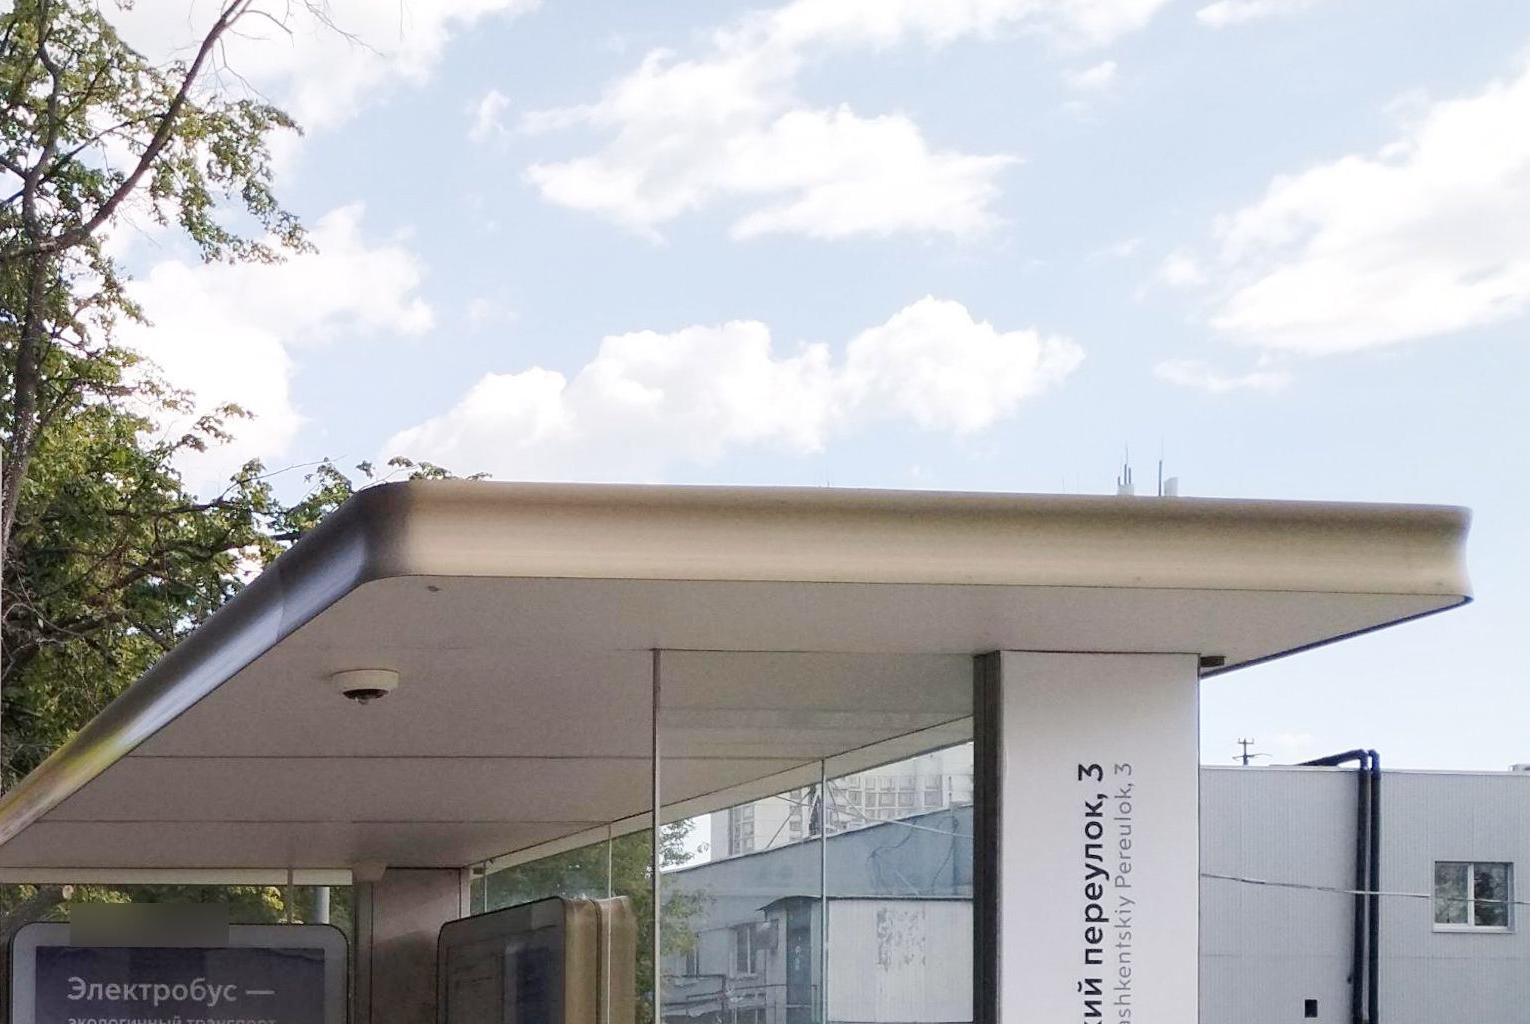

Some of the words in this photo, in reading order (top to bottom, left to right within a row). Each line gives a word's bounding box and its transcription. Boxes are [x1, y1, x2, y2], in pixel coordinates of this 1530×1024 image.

[1078, 763, 1104, 782] 3
[1114, 763, 1132, 776] 3
[1114, 783, 1135, 888] Pereulok,
[1084, 793, 1110, 965] переулок,
[67, 976, 238, 1007] Электробус
